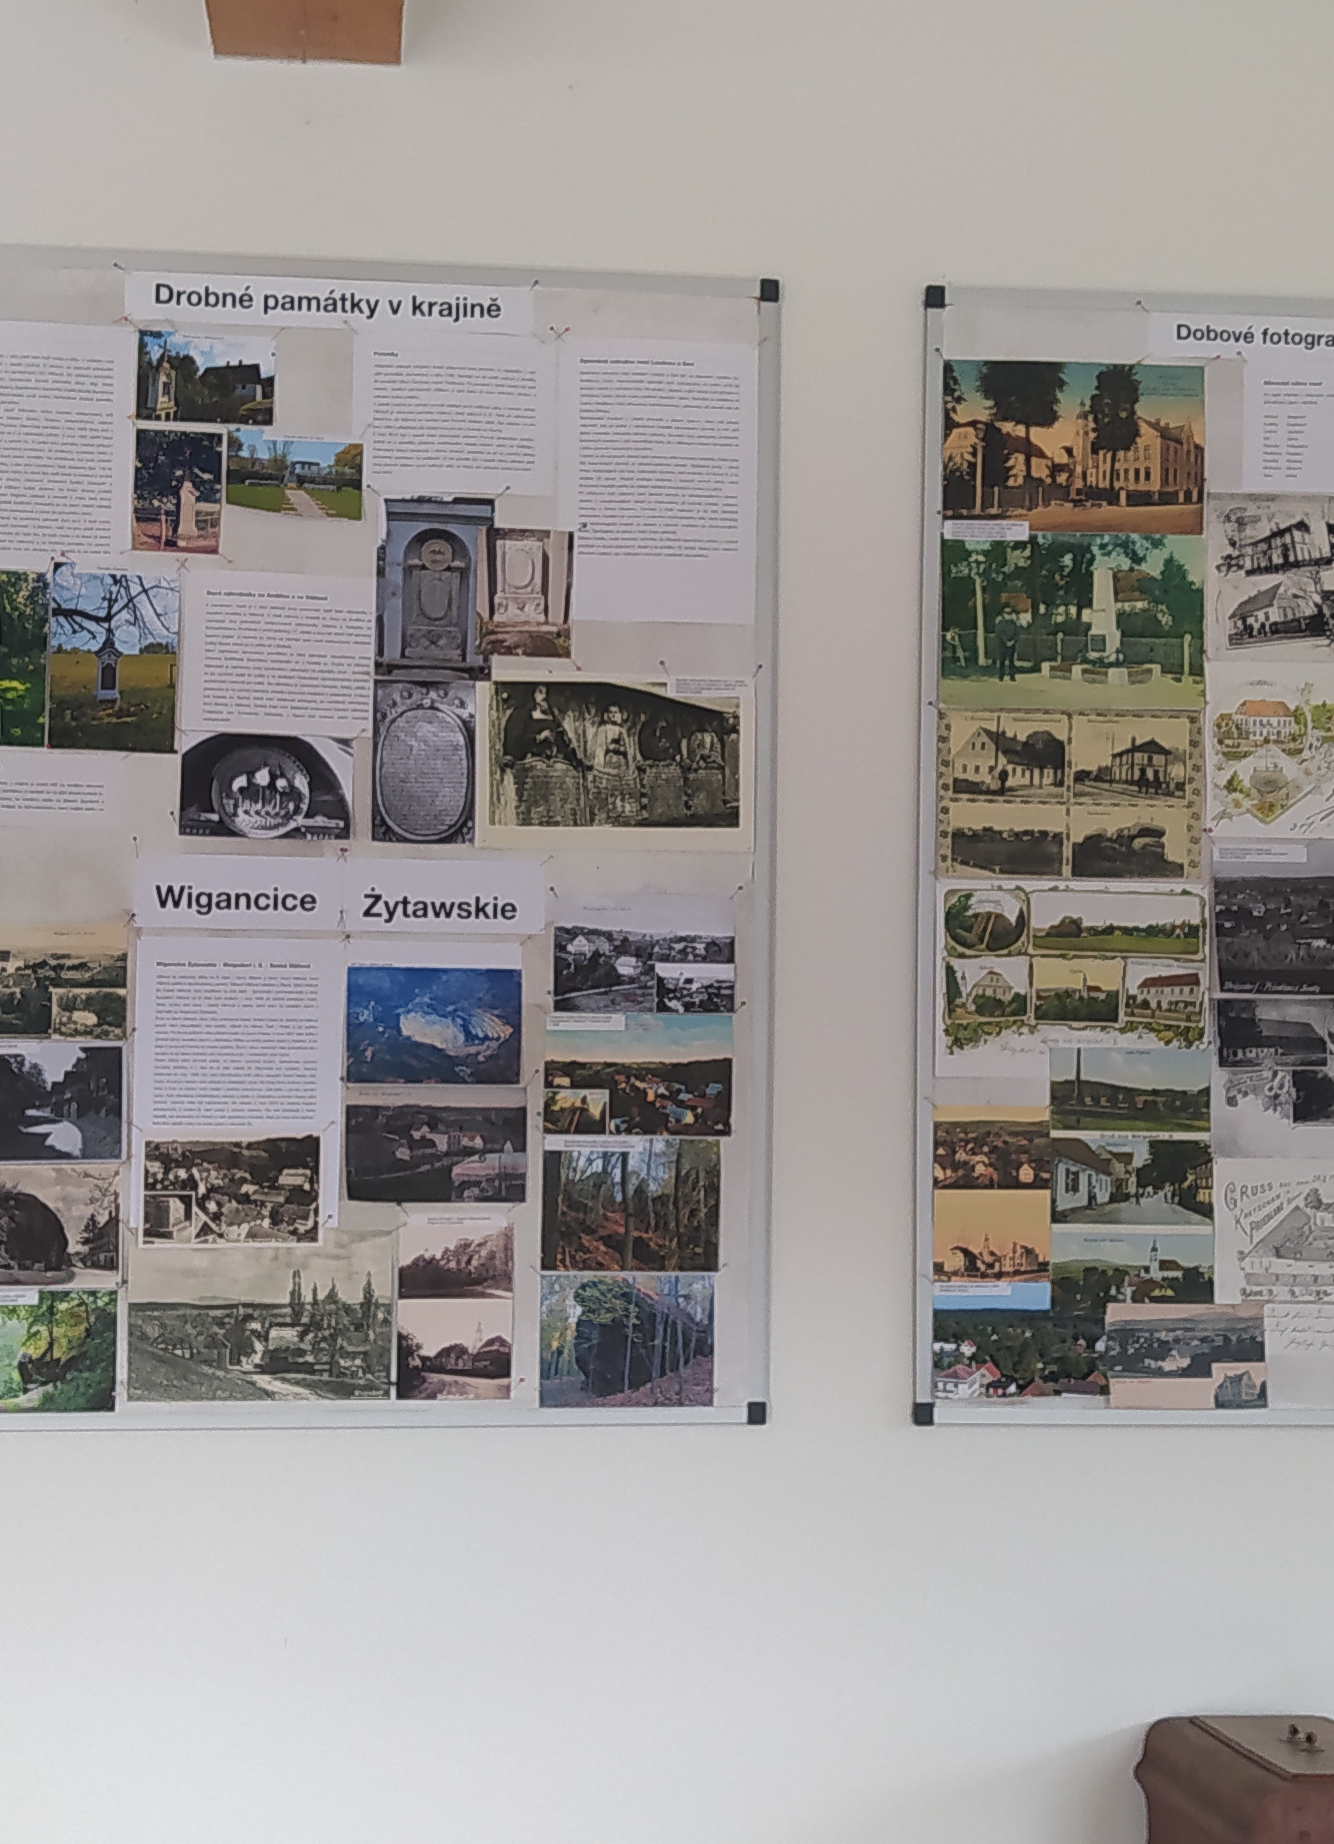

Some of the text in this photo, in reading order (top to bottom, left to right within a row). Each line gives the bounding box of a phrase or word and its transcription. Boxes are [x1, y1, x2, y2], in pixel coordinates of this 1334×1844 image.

[154, 283, 502, 323] Drobné památky v krajině
[1176, 323, 1255, 344] Dobové
[155, 884, 518, 924] Wigancice Żytawskie
[1224, 1181, 1274, 1211] GRUSS
